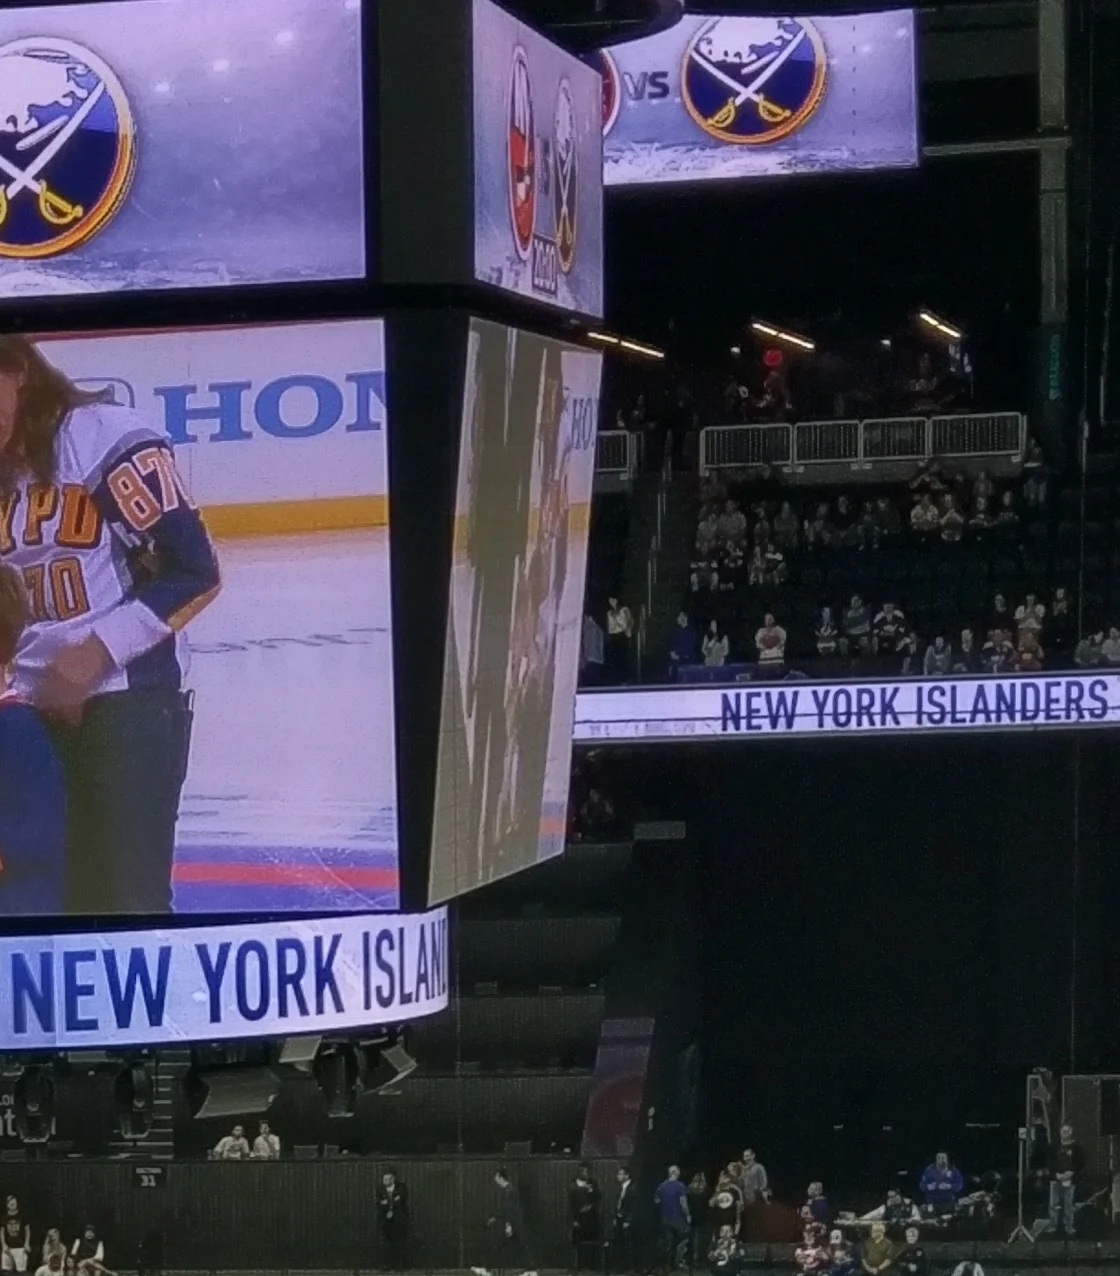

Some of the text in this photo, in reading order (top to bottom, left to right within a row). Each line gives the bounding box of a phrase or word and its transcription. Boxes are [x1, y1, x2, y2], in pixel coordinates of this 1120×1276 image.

[623, 71, 670, 100] VS
[721, 678, 1109, 732] NEW YORK ISLANDERS
[10, 945, 170, 1035] NEW
[195, 933, 344, 1019] YORK
